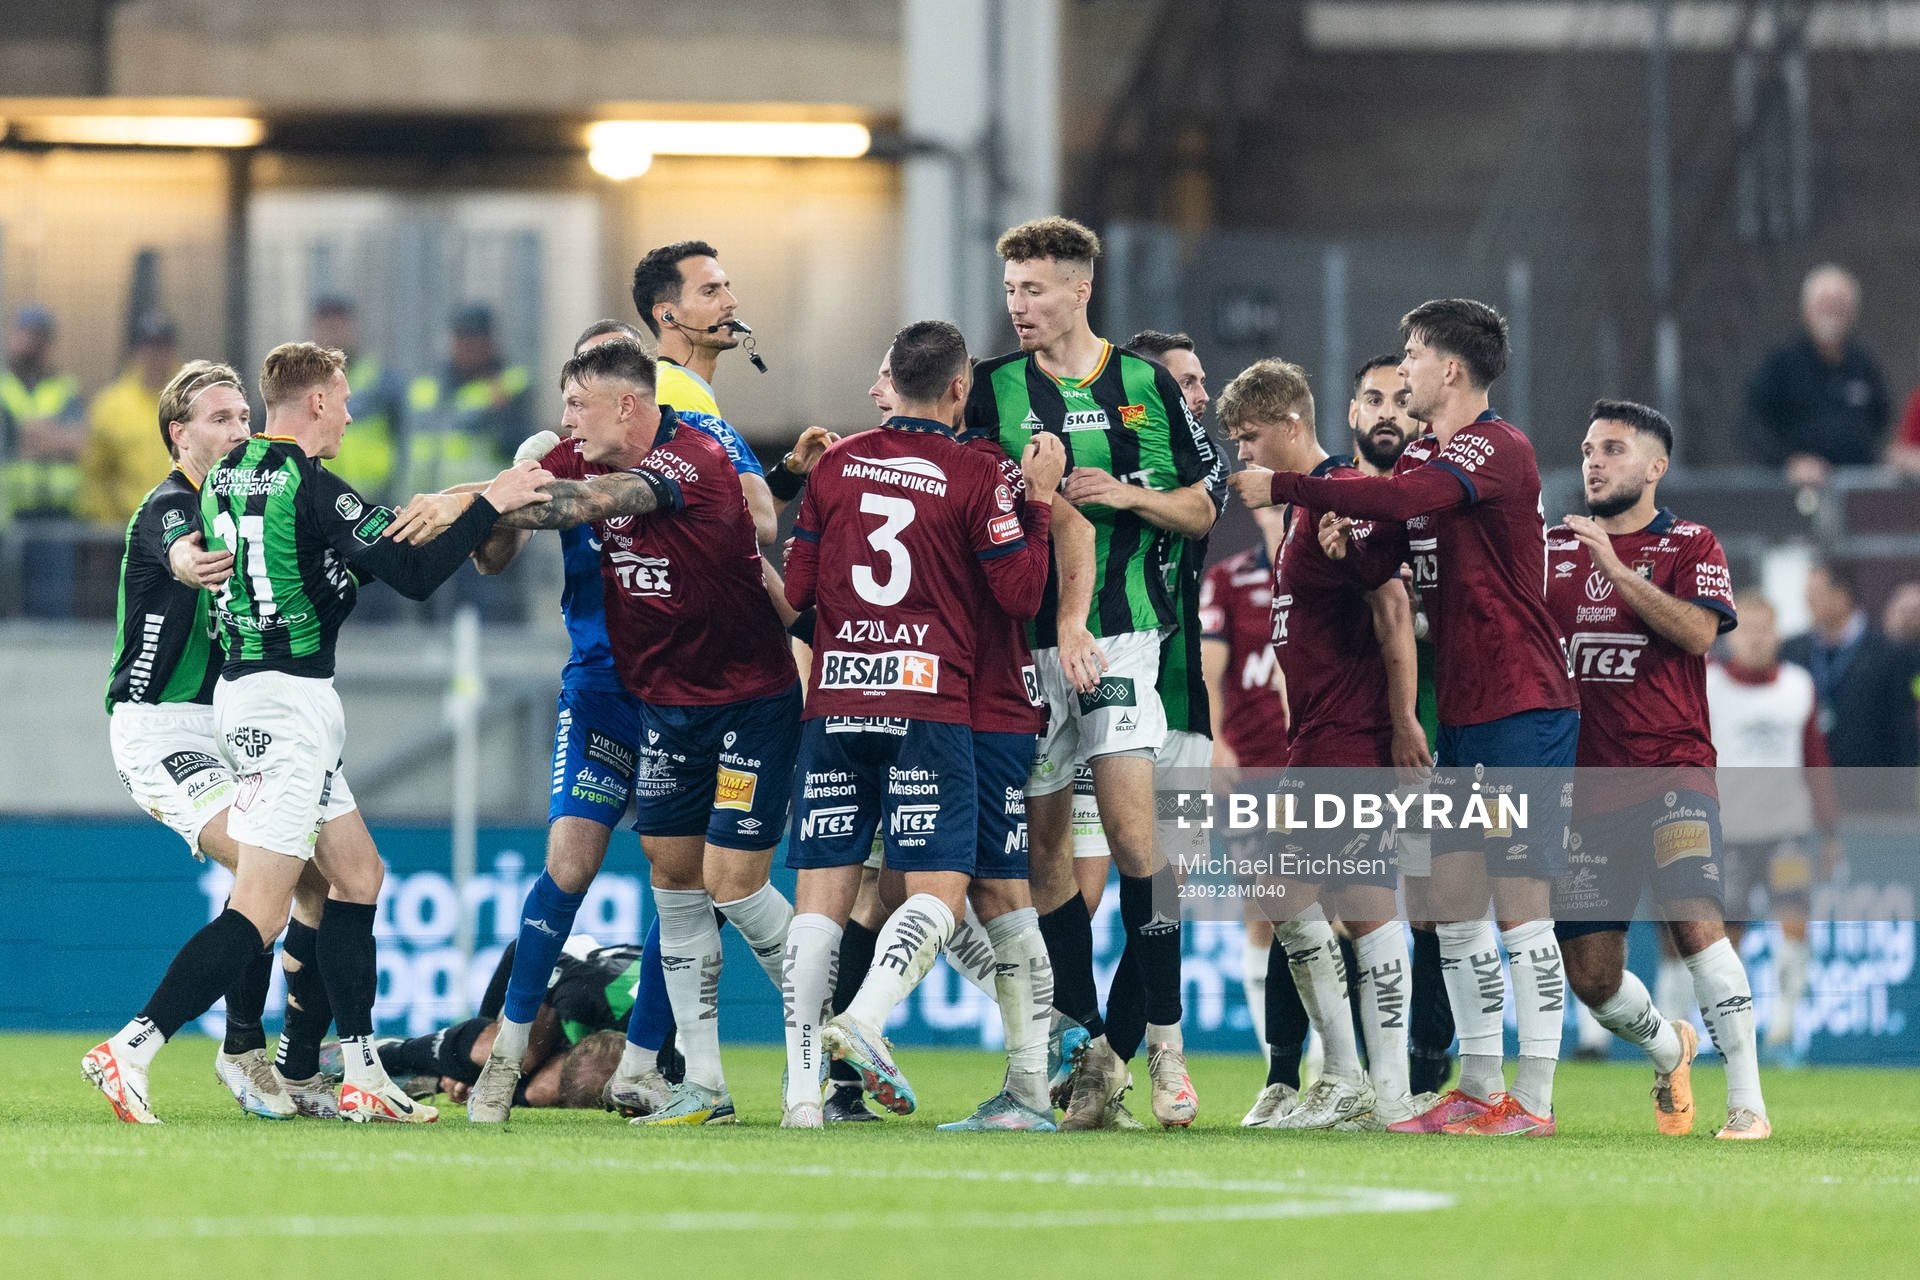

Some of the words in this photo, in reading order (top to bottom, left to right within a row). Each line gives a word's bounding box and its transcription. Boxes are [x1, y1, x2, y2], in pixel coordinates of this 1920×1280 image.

[1066, 413, 1106, 426] SKAB
[1453, 433, 1495, 457] ordic
[841, 463, 948, 498] HAMMARVIKEN
[358, 508, 389, 538] UNIBET
[992, 517, 1019, 534] UNIBE
[851, 492, 917, 608] 3
[1577, 605, 1617, 617] factoring
[835, 620, 930, 646] AZULAY
[824, 655, 900, 687] BESAB
[862, 690, 887, 698] umbro
[883, 726, 908, 737] GROUP
[169, 752, 213, 768] VIRTU
[246, 745, 267, 759] UP
[591, 733, 634, 766] VIRTUAL
[898, 837, 927, 847] umbro
[880, 908, 938, 977] MIKE
[1469, 948, 1505, 1014] MIKE
[1529, 944, 1564, 1013] MIKE
[1371, 958, 1404, 1029] MIKE
[800, 1023, 812, 1070] umbro
